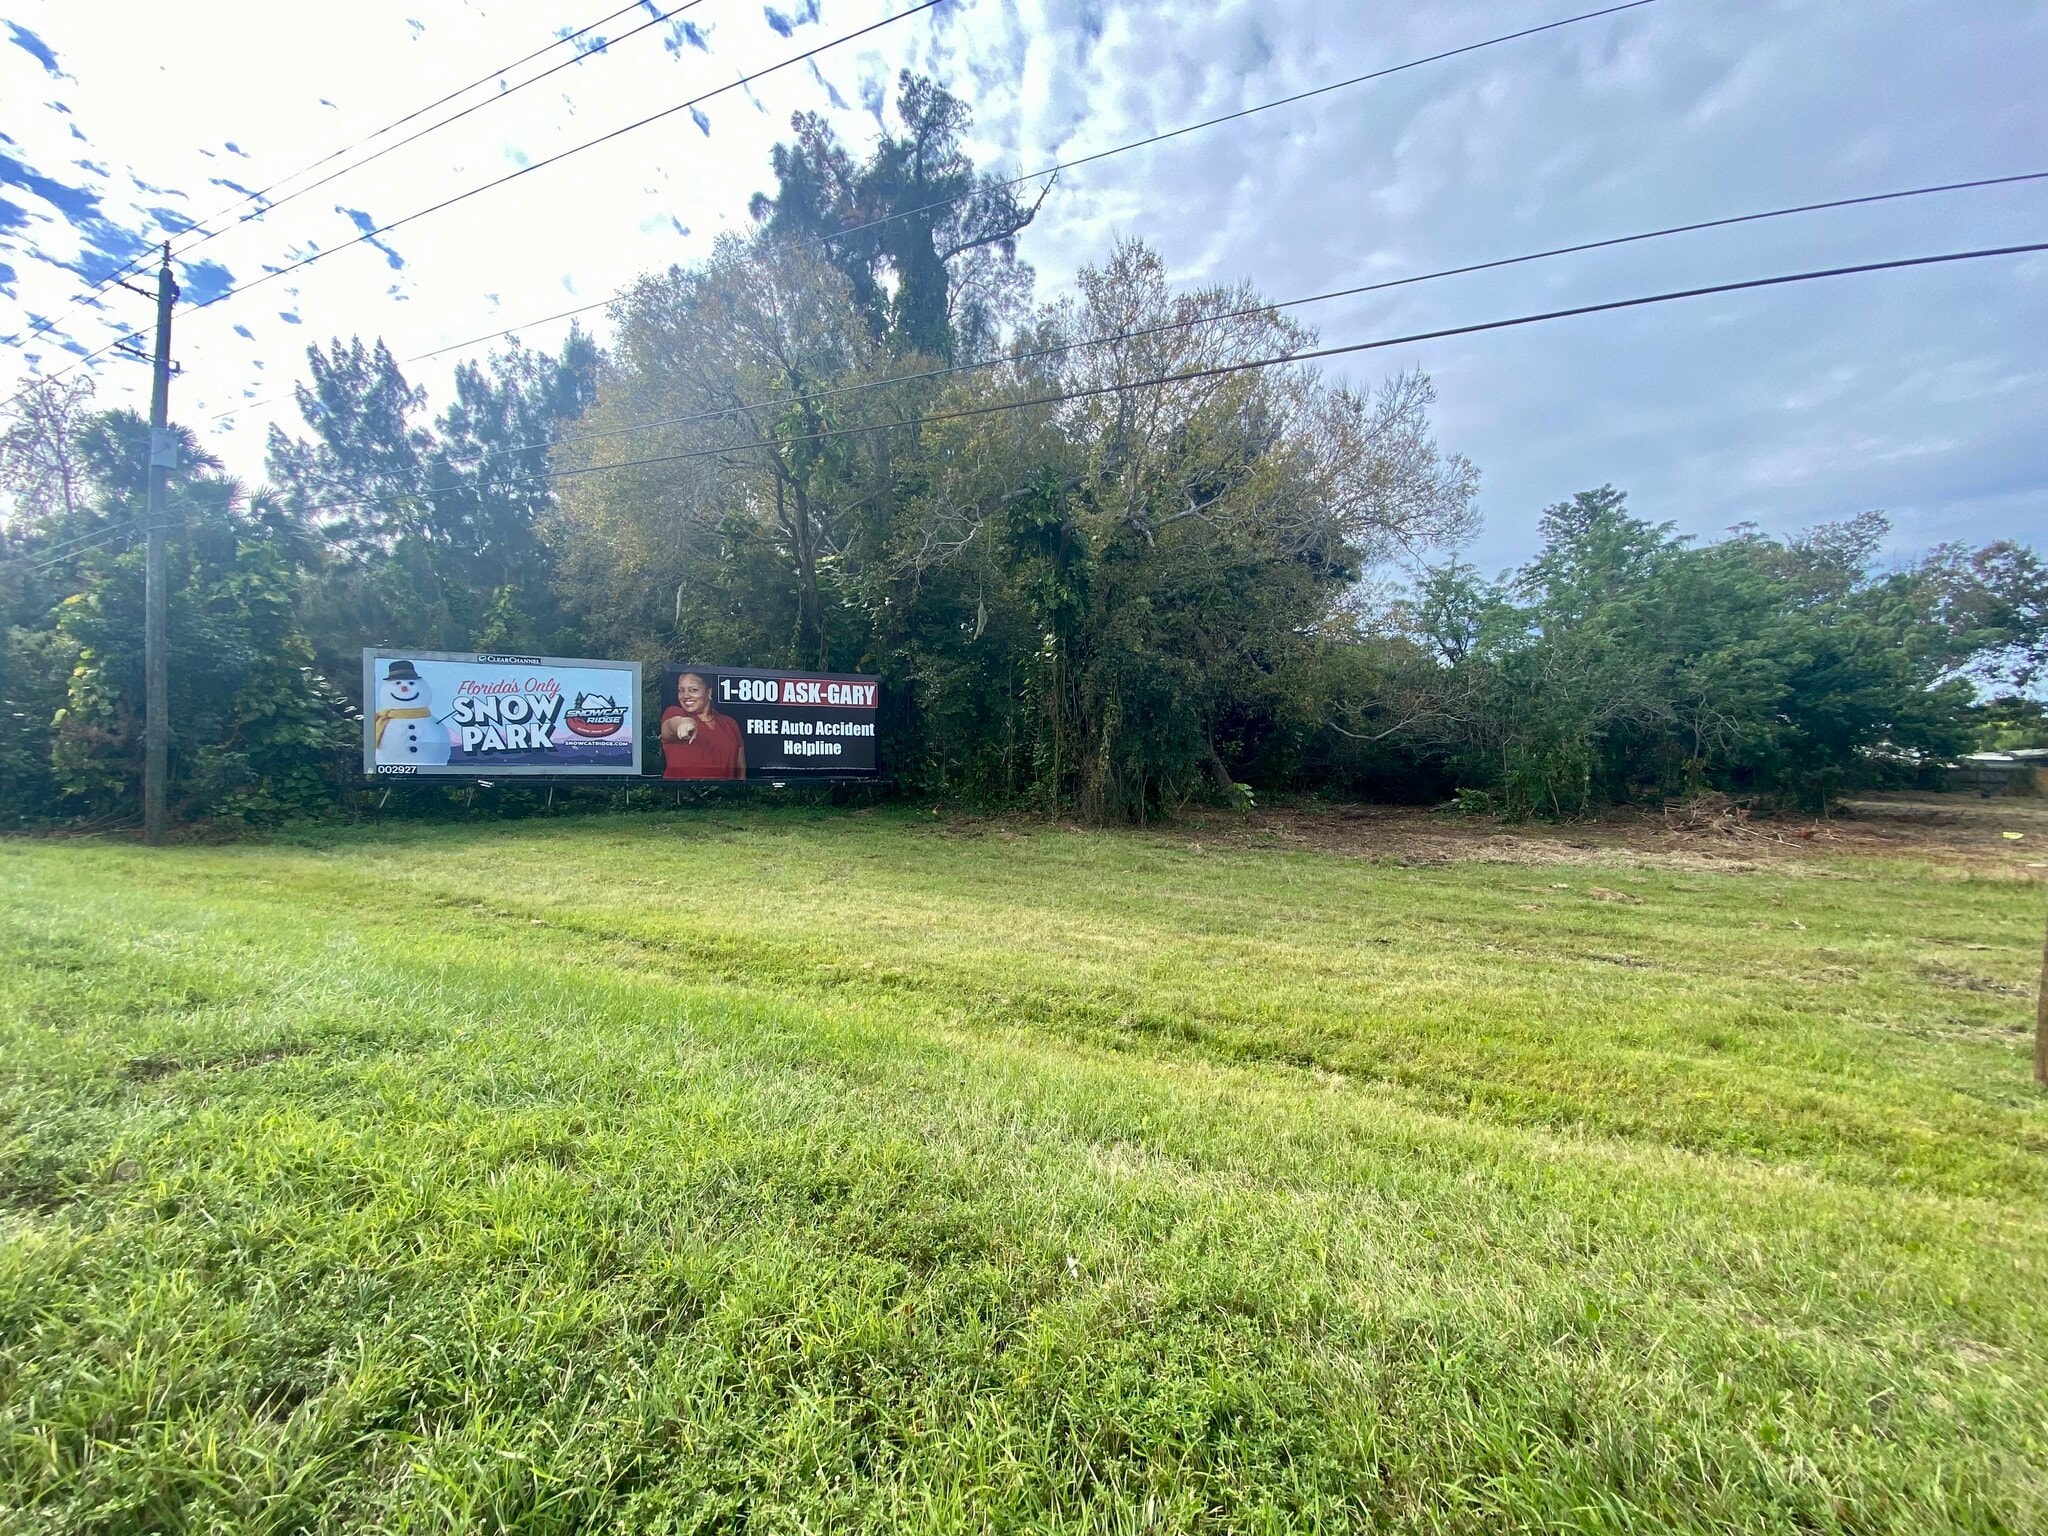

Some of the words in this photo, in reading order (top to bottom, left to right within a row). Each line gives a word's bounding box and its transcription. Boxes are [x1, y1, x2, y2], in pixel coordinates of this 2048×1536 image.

[457, 679, 520, 695] Florida's
[524, 677, 561, 699] Only
[720, 679, 778, 702] 1-800
[782, 682, 875, 705] ASK-GARY
[451, 694, 564, 726] SNOW
[566, 708, 627, 717] SNOWCAT
[746, 719, 779, 734] FREE
[780, 720, 813, 736] Auto
[815, 721, 875, 737] Accident
[461, 722, 557, 755] PARK
[783, 740, 842, 756] Helpline
[378, 765, 417, 774] 002927
